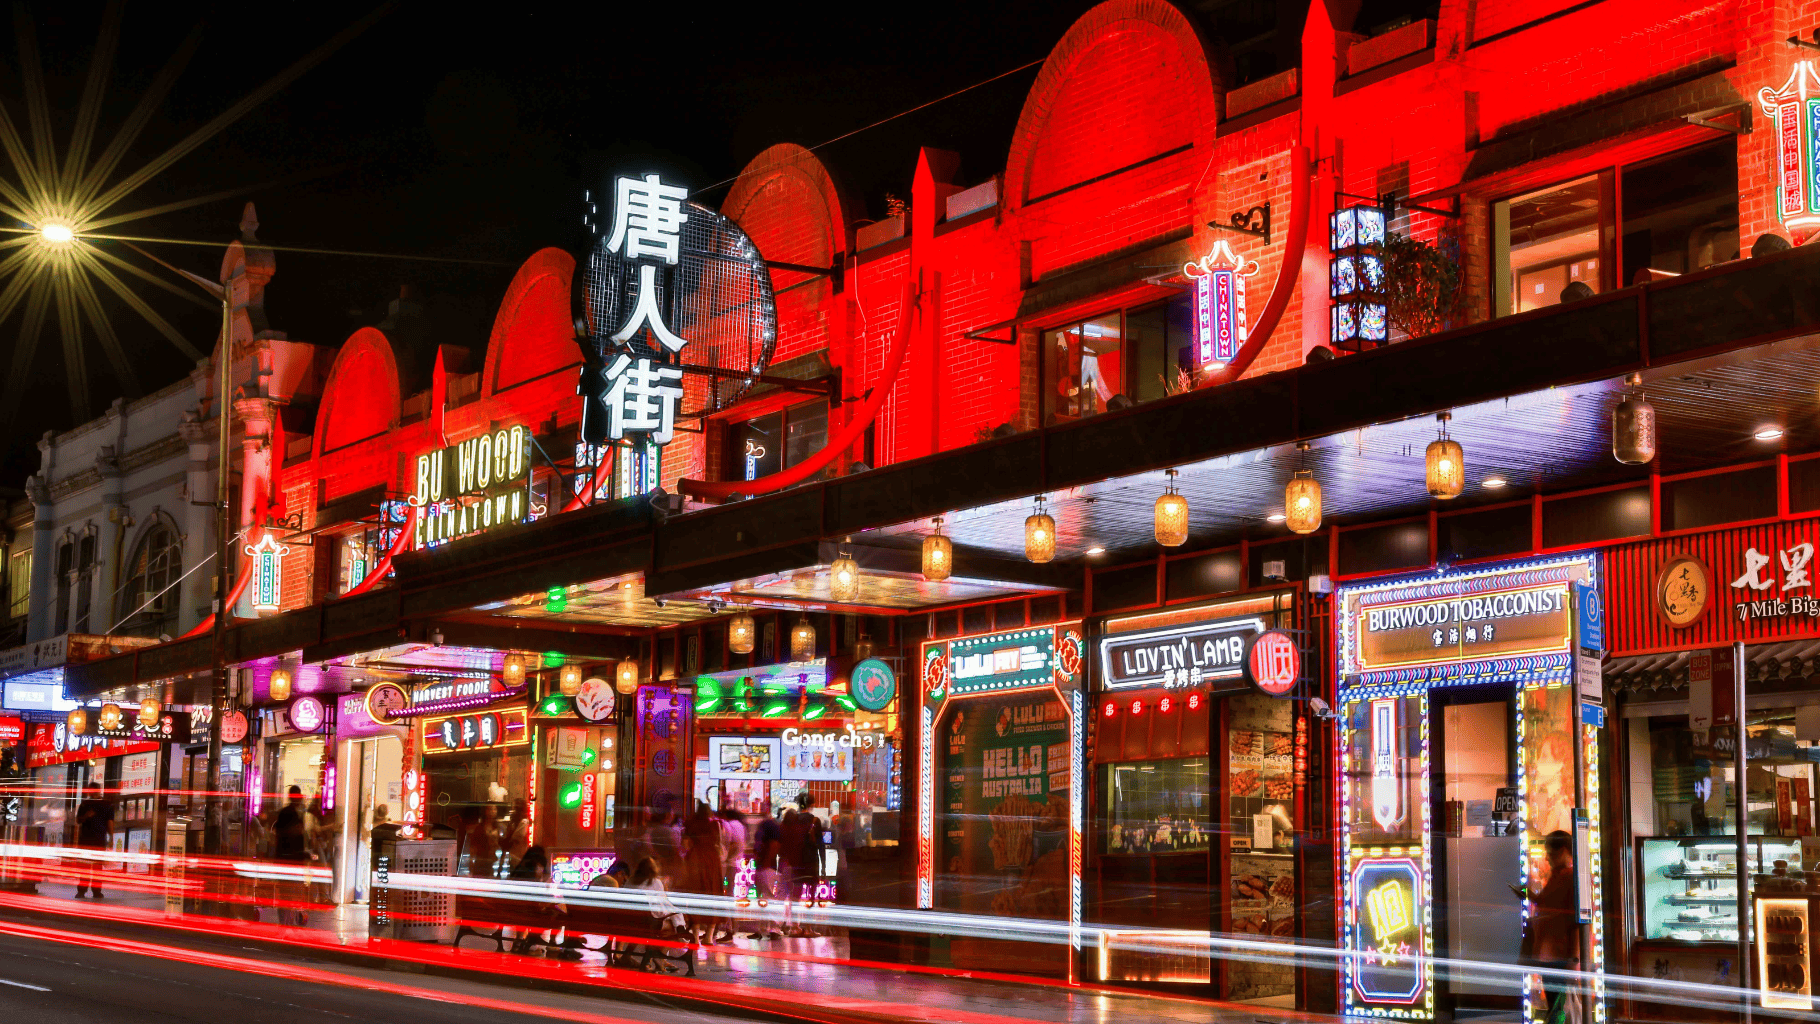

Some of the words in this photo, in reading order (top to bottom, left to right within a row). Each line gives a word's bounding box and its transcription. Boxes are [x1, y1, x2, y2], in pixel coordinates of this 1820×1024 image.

[601, 174, 688, 443] 唐人街
[1219, 276, 1230, 356] CHINATOWN
[416, 491, 520, 550] CHINATOWN
[1369, 603, 1448, 631] BURWOOD
[1451, 589, 1562, 622] TOBACCONIST
[1737, 603, 1748, 621] 7
[1751, 597, 1787, 618] Mile
[1791, 596, 1820, 617] Big
[1124, 637, 1188, 675] LOVIN'
[1191, 636, 1243, 666] LAMB
[1692, 657, 1708, 668] BUS
[1690, 669, 1710, 680] ZONE
[413, 685, 453, 703] HARVEST
[456, 680, 490, 697] FOODIE
[1013, 704, 1044, 725] LULU
[782, 727, 836, 753] Gong
[983, 744, 1042, 779] HELLO
[583, 774, 594, 803] Order
[982, 777, 1042, 798] AUSTRALIA
[582, 804, 594, 828] Here
[1496, 796, 1519, 811] OPEN
